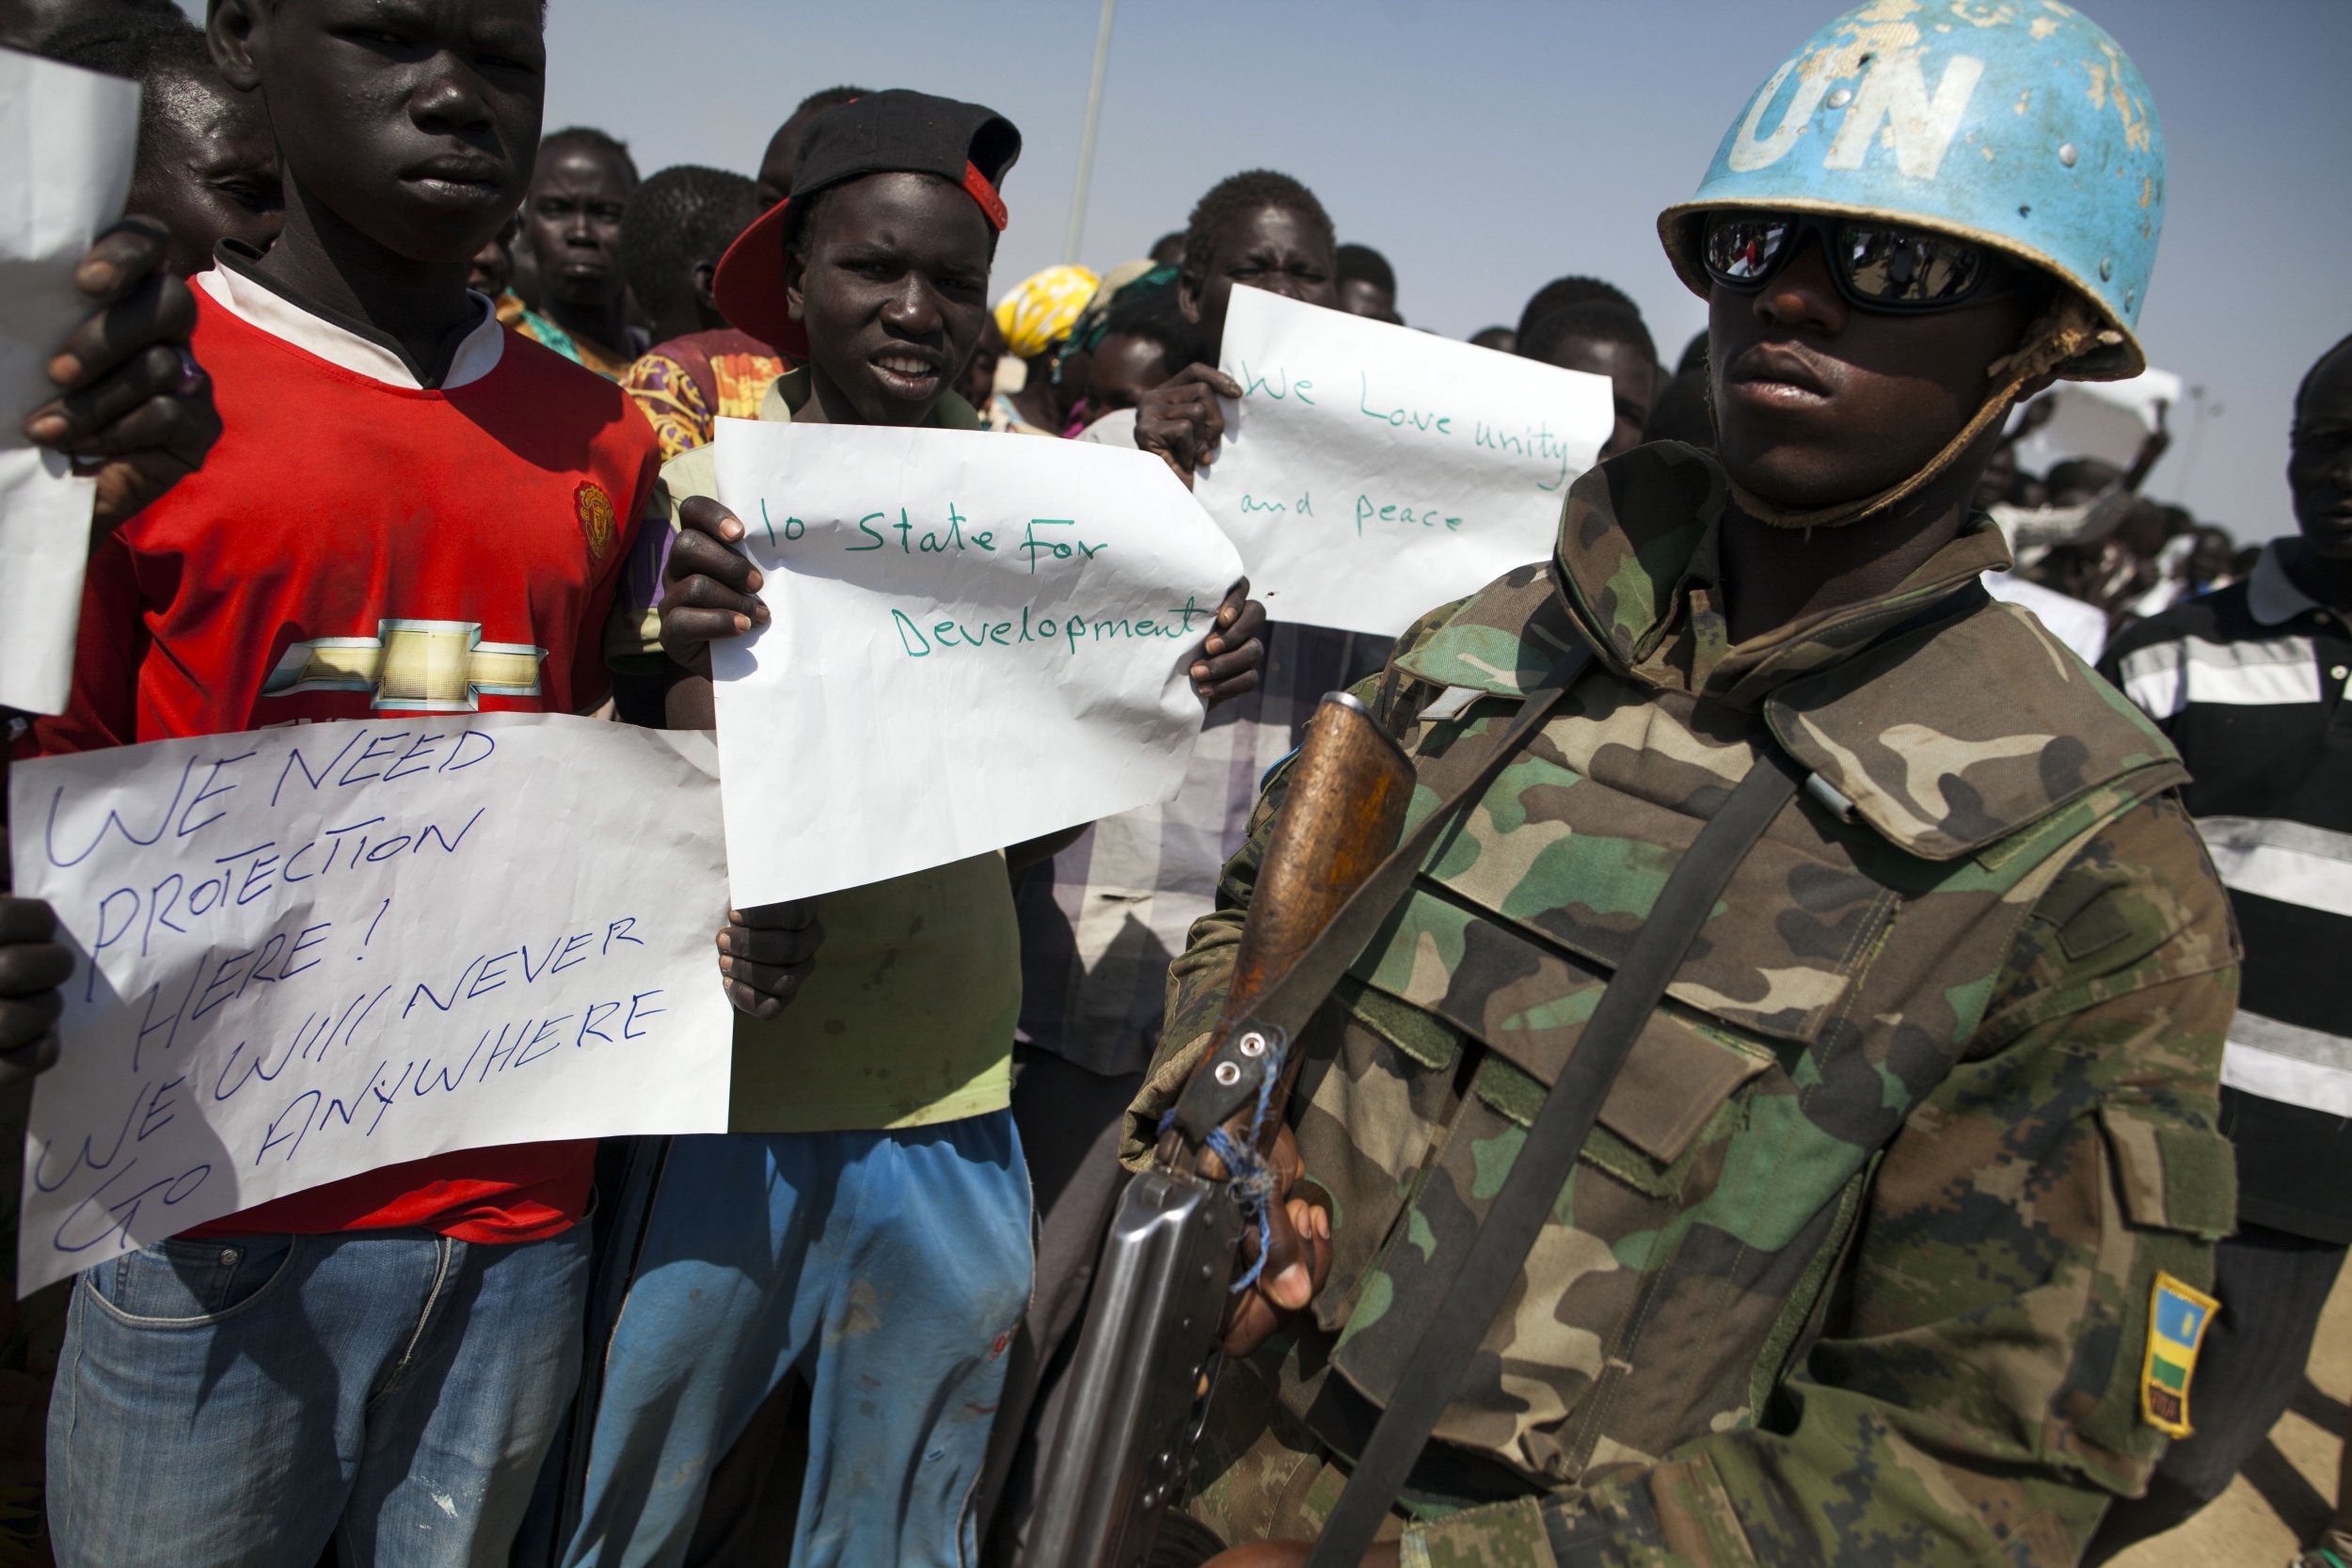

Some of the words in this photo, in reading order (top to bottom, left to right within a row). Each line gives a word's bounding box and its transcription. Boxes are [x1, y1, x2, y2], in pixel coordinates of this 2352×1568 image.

[1727, 48, 1985, 180] UN
[1241, 359, 1315, 405] We
[1360, 370, 1452, 436] Love
[1474, 420, 1568, 491] unity
[844, 502, 996, 555] State
[1019, 518, 1108, 575] For
[1240, 490, 1314, 517] and
[891, 595, 1210, 657] Development
[46, 751, 258, 867] WE
[270, 728, 495, 807] NEED
[86, 807, 485, 1003] PROTECTION
[35, 1074, 187, 1193] WE
[402, 916, 644, 1020] NEVER
[255, 989, 667, 1165] ANYWHERE
